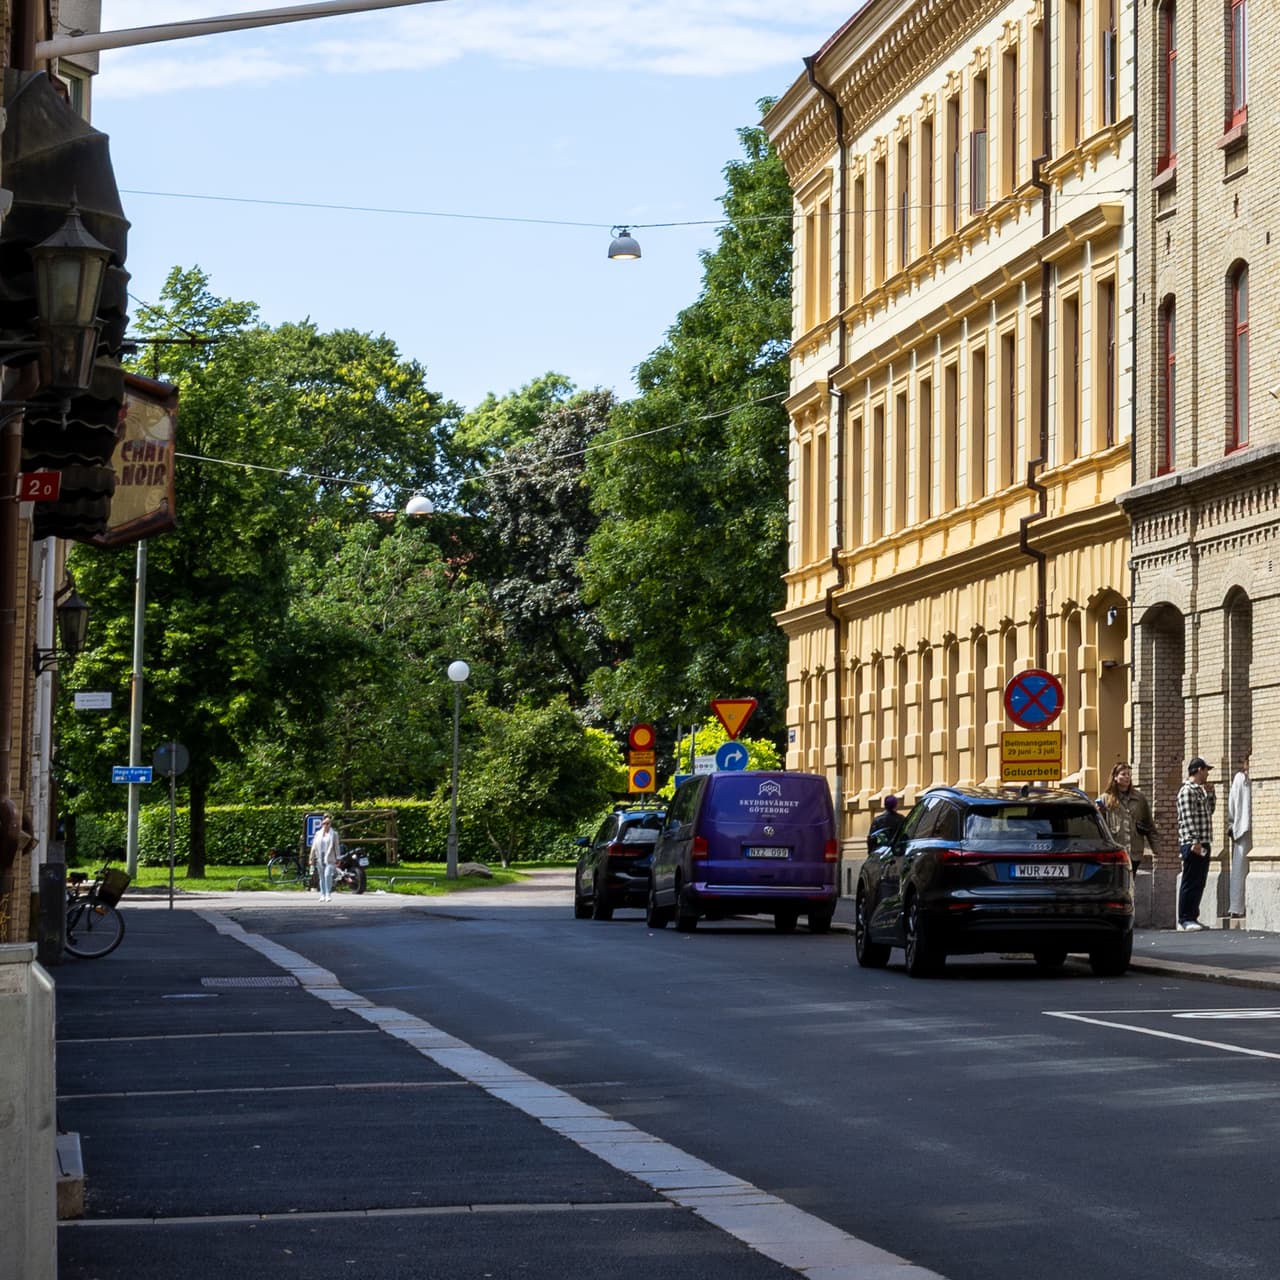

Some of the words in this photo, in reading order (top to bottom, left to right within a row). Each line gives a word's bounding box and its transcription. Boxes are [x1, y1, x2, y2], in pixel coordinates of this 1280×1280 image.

[121, 440, 165, 462] CHAT
[121, 463, 167, 486] NOIR
[1005, 740, 1058, 748] Bellmansgatan
[1017, 748, 1032, 756] juni
[1043, 747, 1055, 755] juli
[1004, 767, 1059, 777] Gatuarbete
[749, 806, 790, 814] GÖTEBORG
[1019, 865, 1040, 876] WUR
[1043, 865, 1065, 876] 47X
